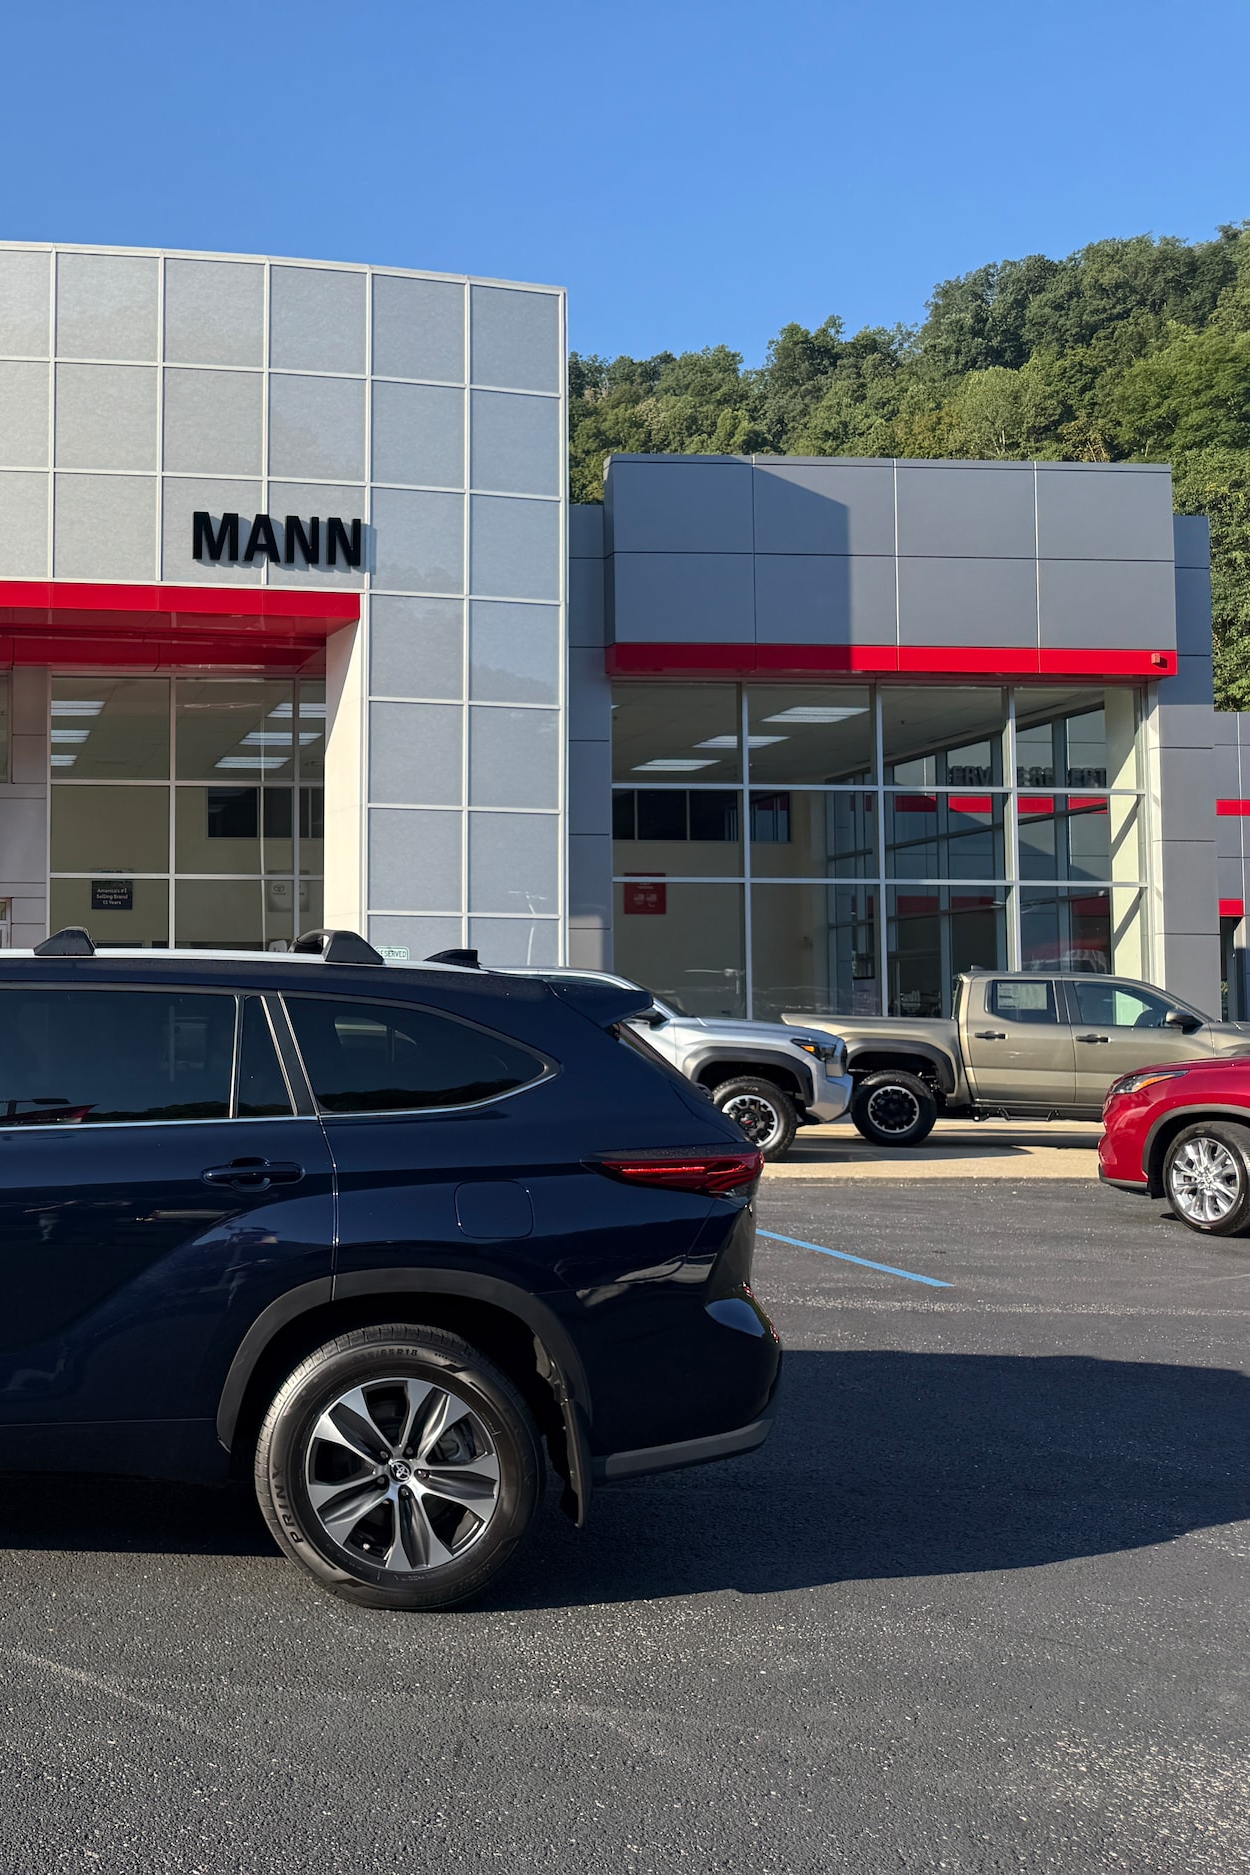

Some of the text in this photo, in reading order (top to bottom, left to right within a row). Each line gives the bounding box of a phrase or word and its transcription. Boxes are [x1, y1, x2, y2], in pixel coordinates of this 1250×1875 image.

[193, 512, 362, 566] MANN
[379, 950, 407, 958] ESERVED
[272, 1462, 303, 1543] PRINX
